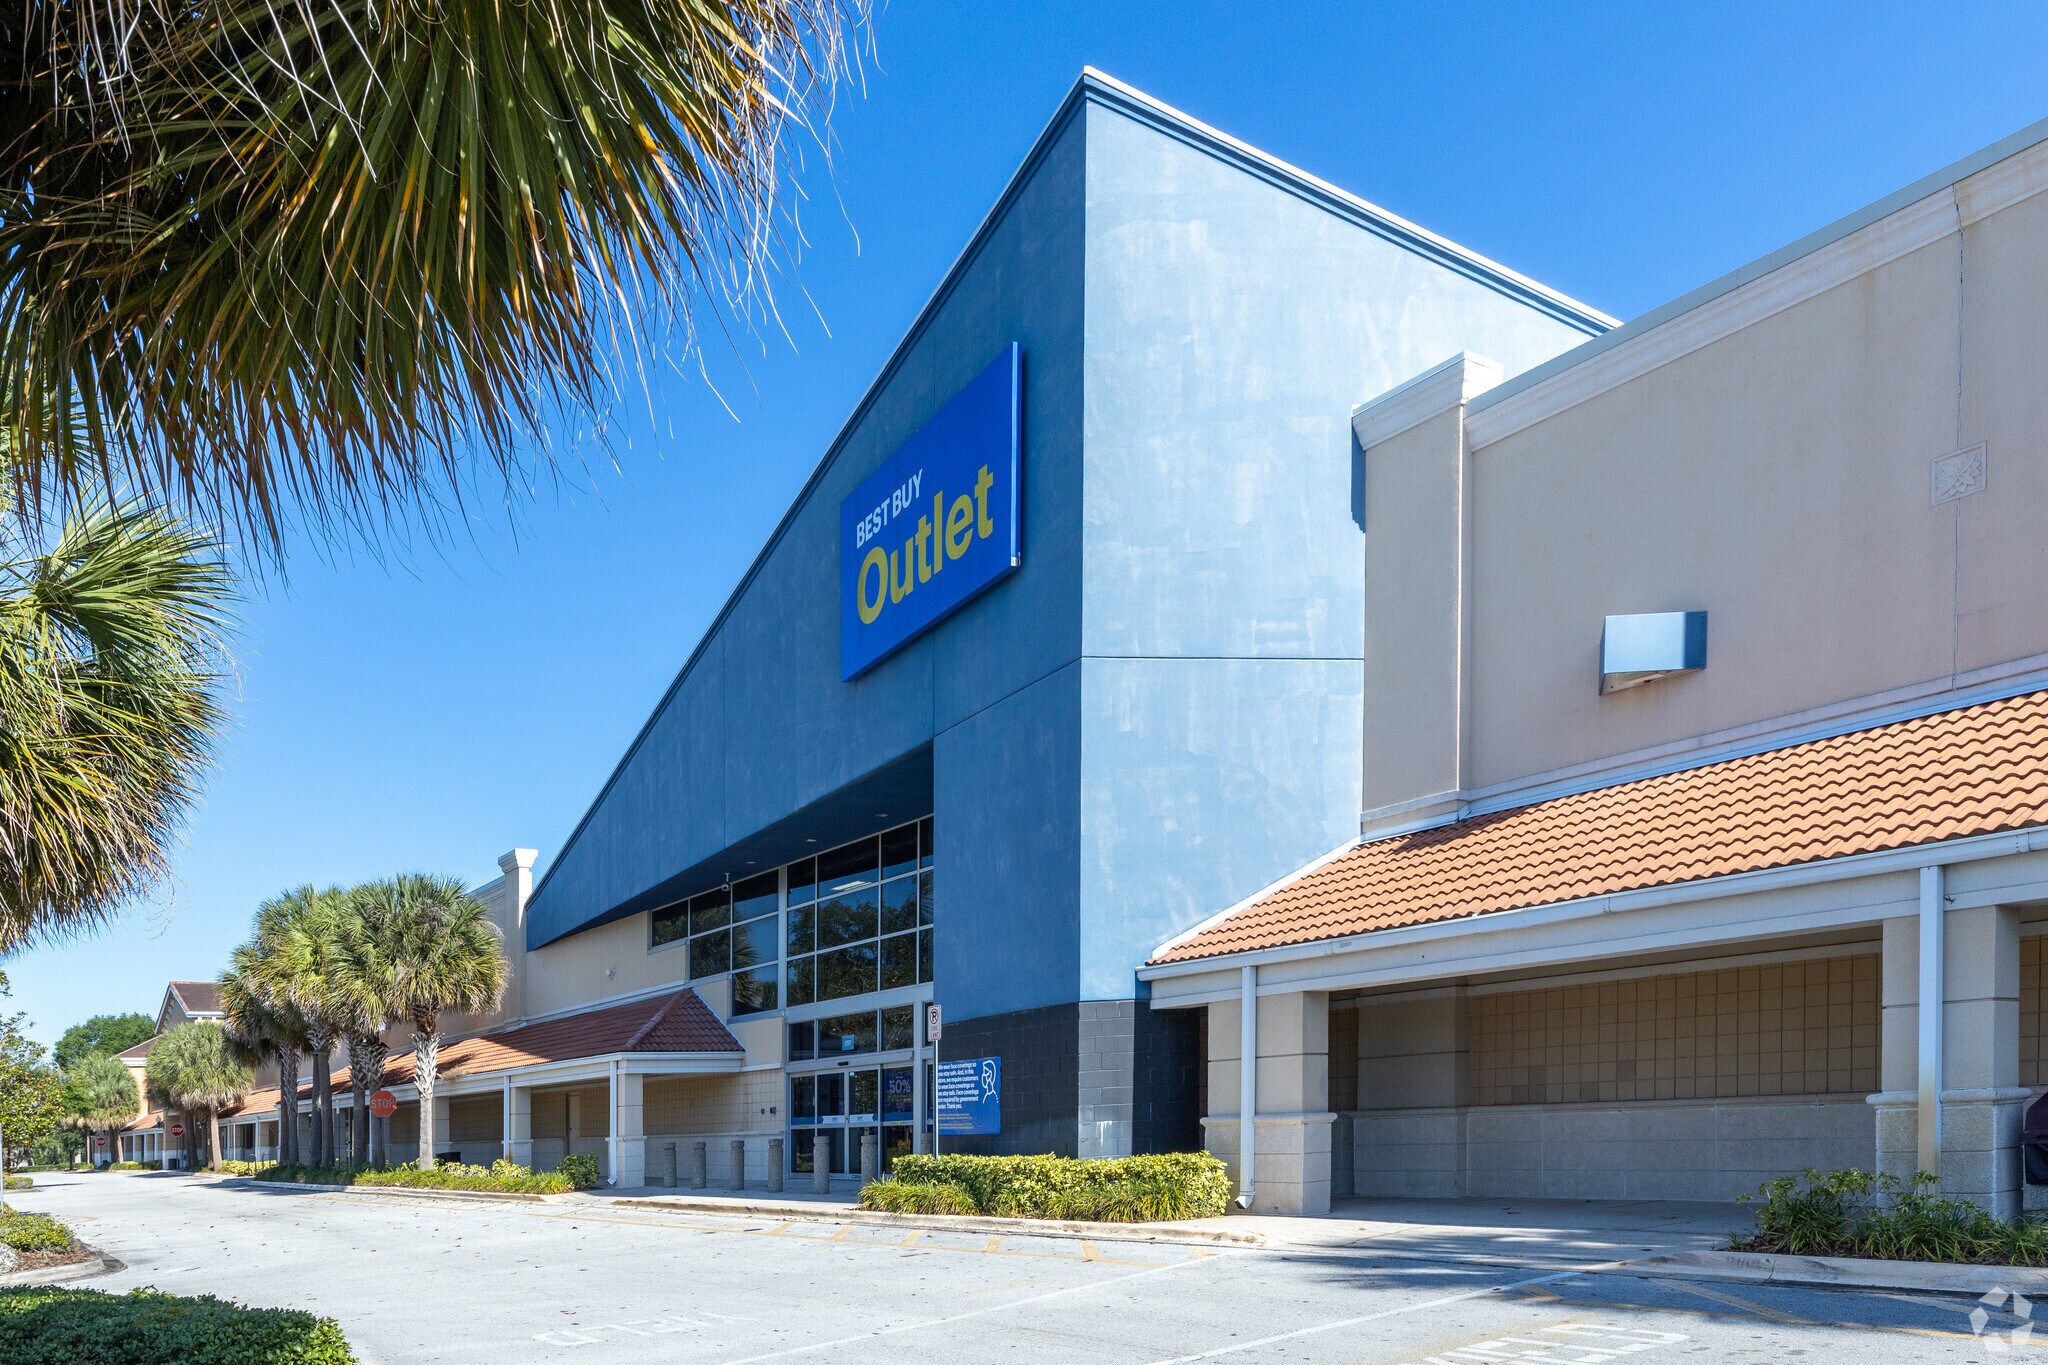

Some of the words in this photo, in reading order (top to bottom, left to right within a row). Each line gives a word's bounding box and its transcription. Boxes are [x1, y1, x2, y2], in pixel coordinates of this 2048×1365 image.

[857, 498, 890, 549] BEST
[893, 468, 923, 518] BUY
[857, 464, 994, 625] Outlet
[371, 1098, 395, 1109] STOP
[889, 1078, 911, 1094] 50%
